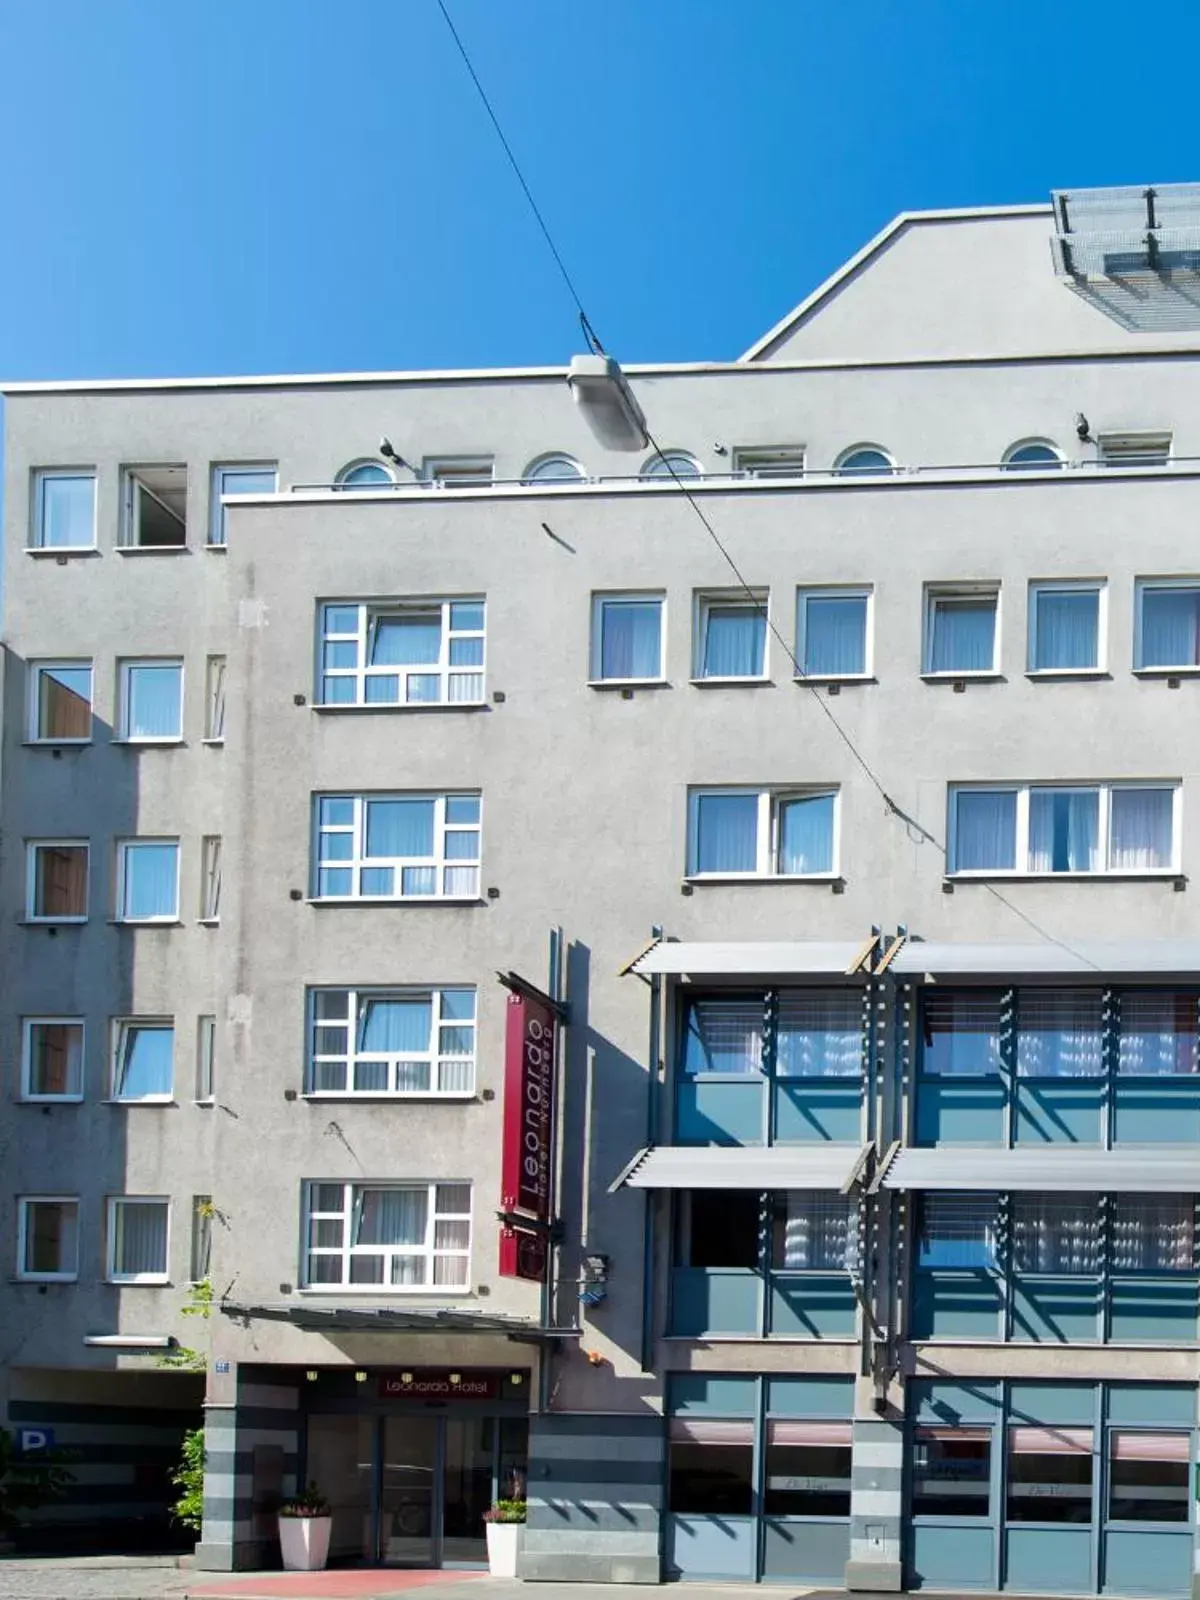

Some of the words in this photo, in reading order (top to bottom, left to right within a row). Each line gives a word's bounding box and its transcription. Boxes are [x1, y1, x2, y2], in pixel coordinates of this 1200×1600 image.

[521, 1019, 543, 1194] Leonardo
[386, 1380, 449, 1392] Leonardo
[452, 1381, 488, 1393] Hotel
[22, 1431, 46, 1451] P
